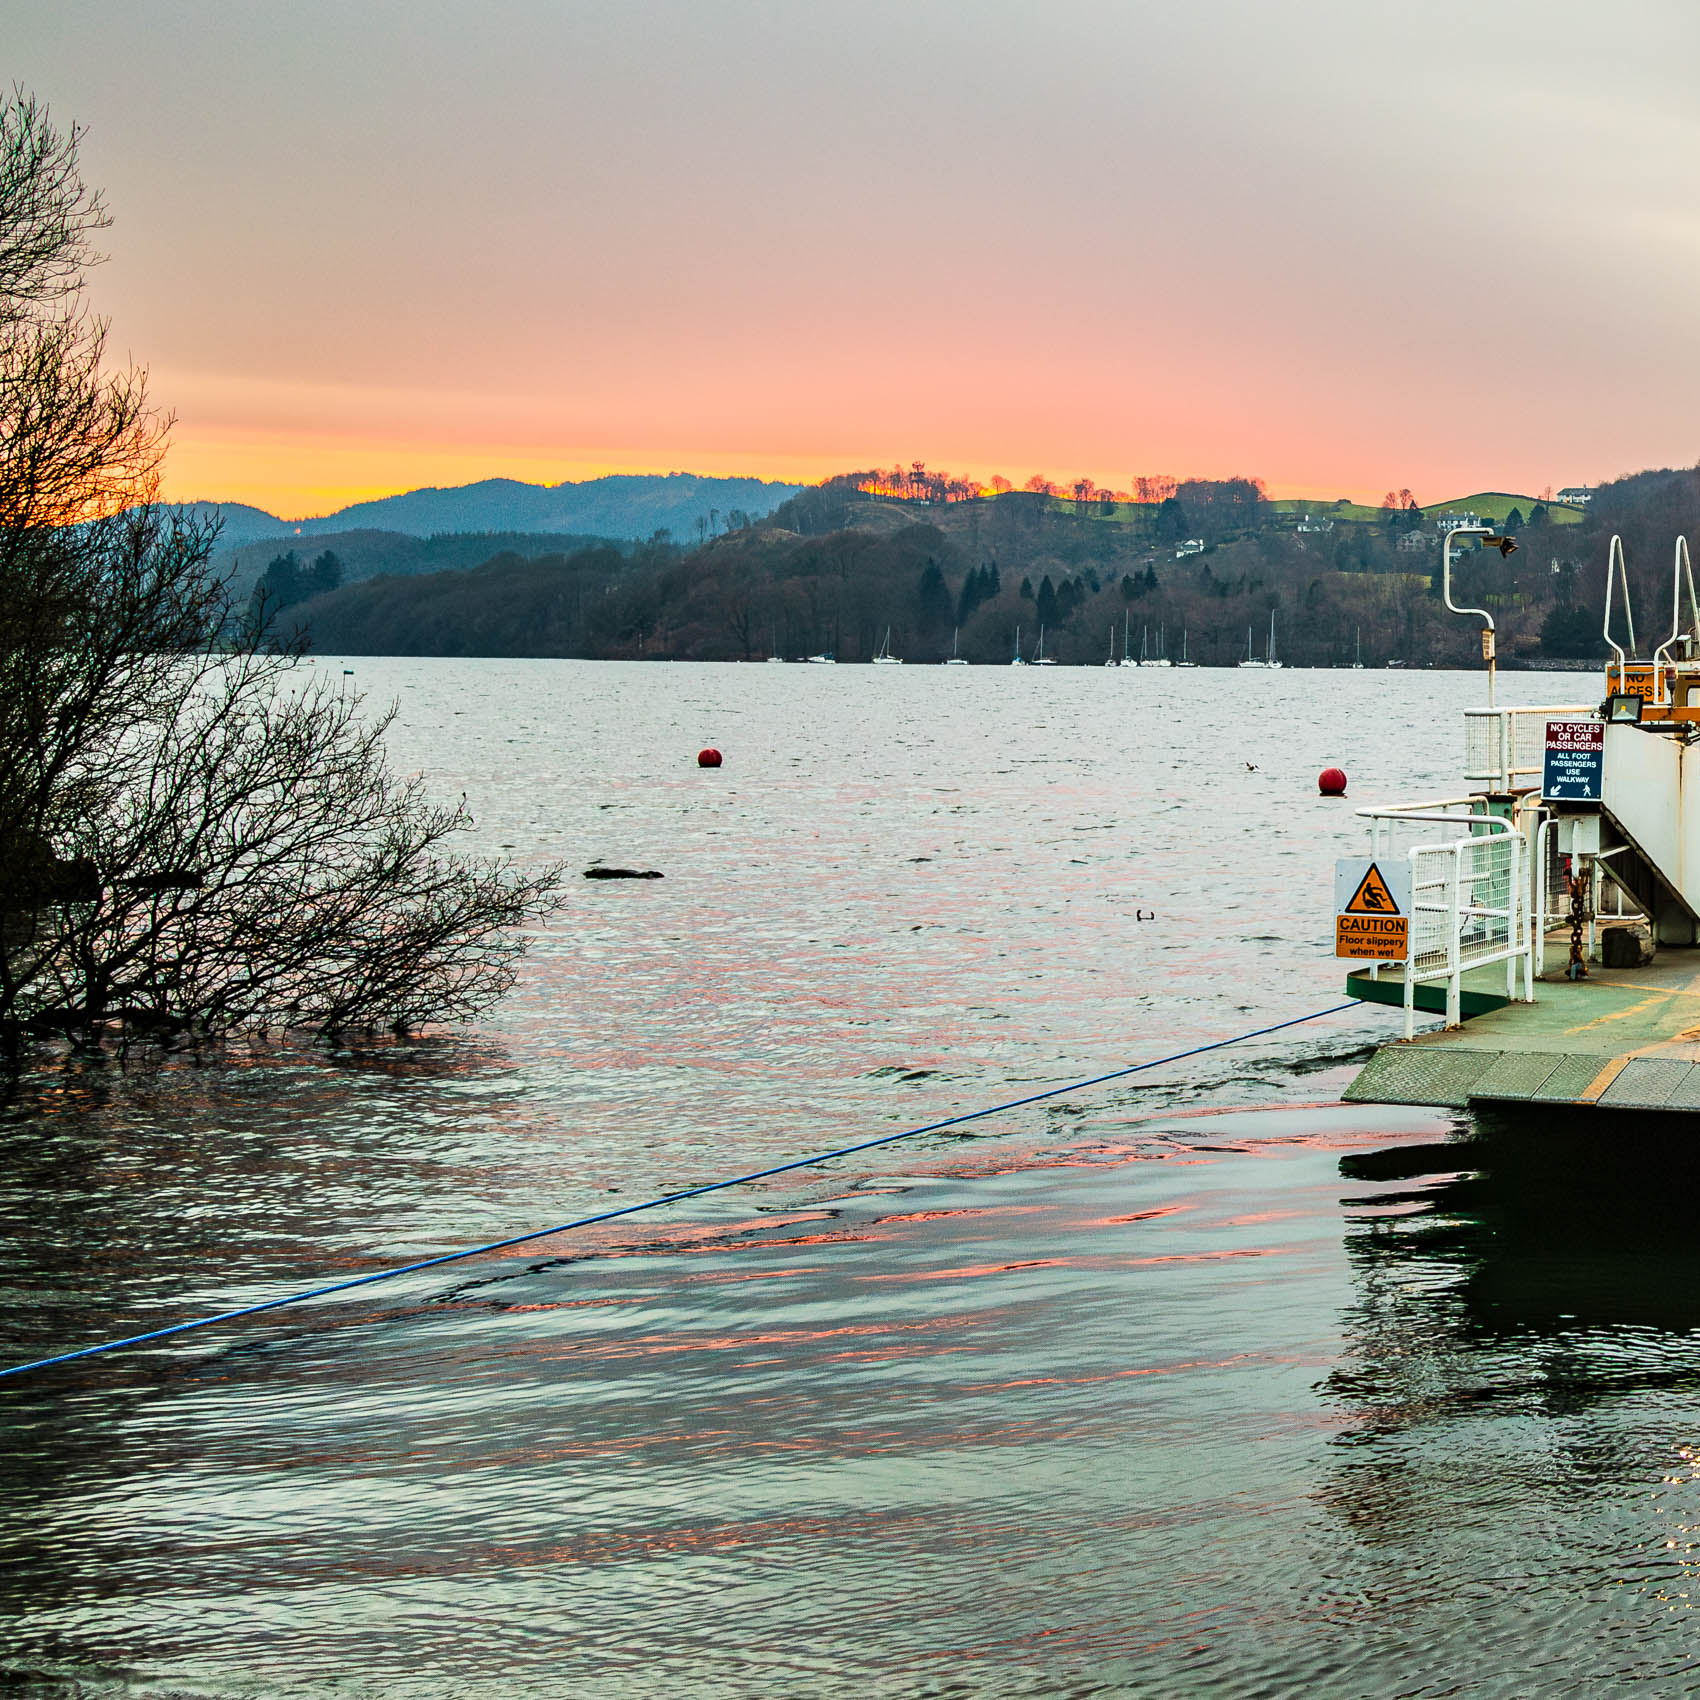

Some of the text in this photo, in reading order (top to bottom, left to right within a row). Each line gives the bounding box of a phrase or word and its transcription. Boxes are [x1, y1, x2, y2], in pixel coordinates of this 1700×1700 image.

[1627, 671, 1645, 683] NO
[1550, 724, 1600, 733] NO CYCLES
[1558, 733, 1592, 741] OR CAR
[1546, 741, 1603, 751] PASSENGERS
[1340, 918, 1405, 932] CAUTION
[1340, 935, 1404, 948] Floor slippery
[1350, 947, 1394, 957] when wet
